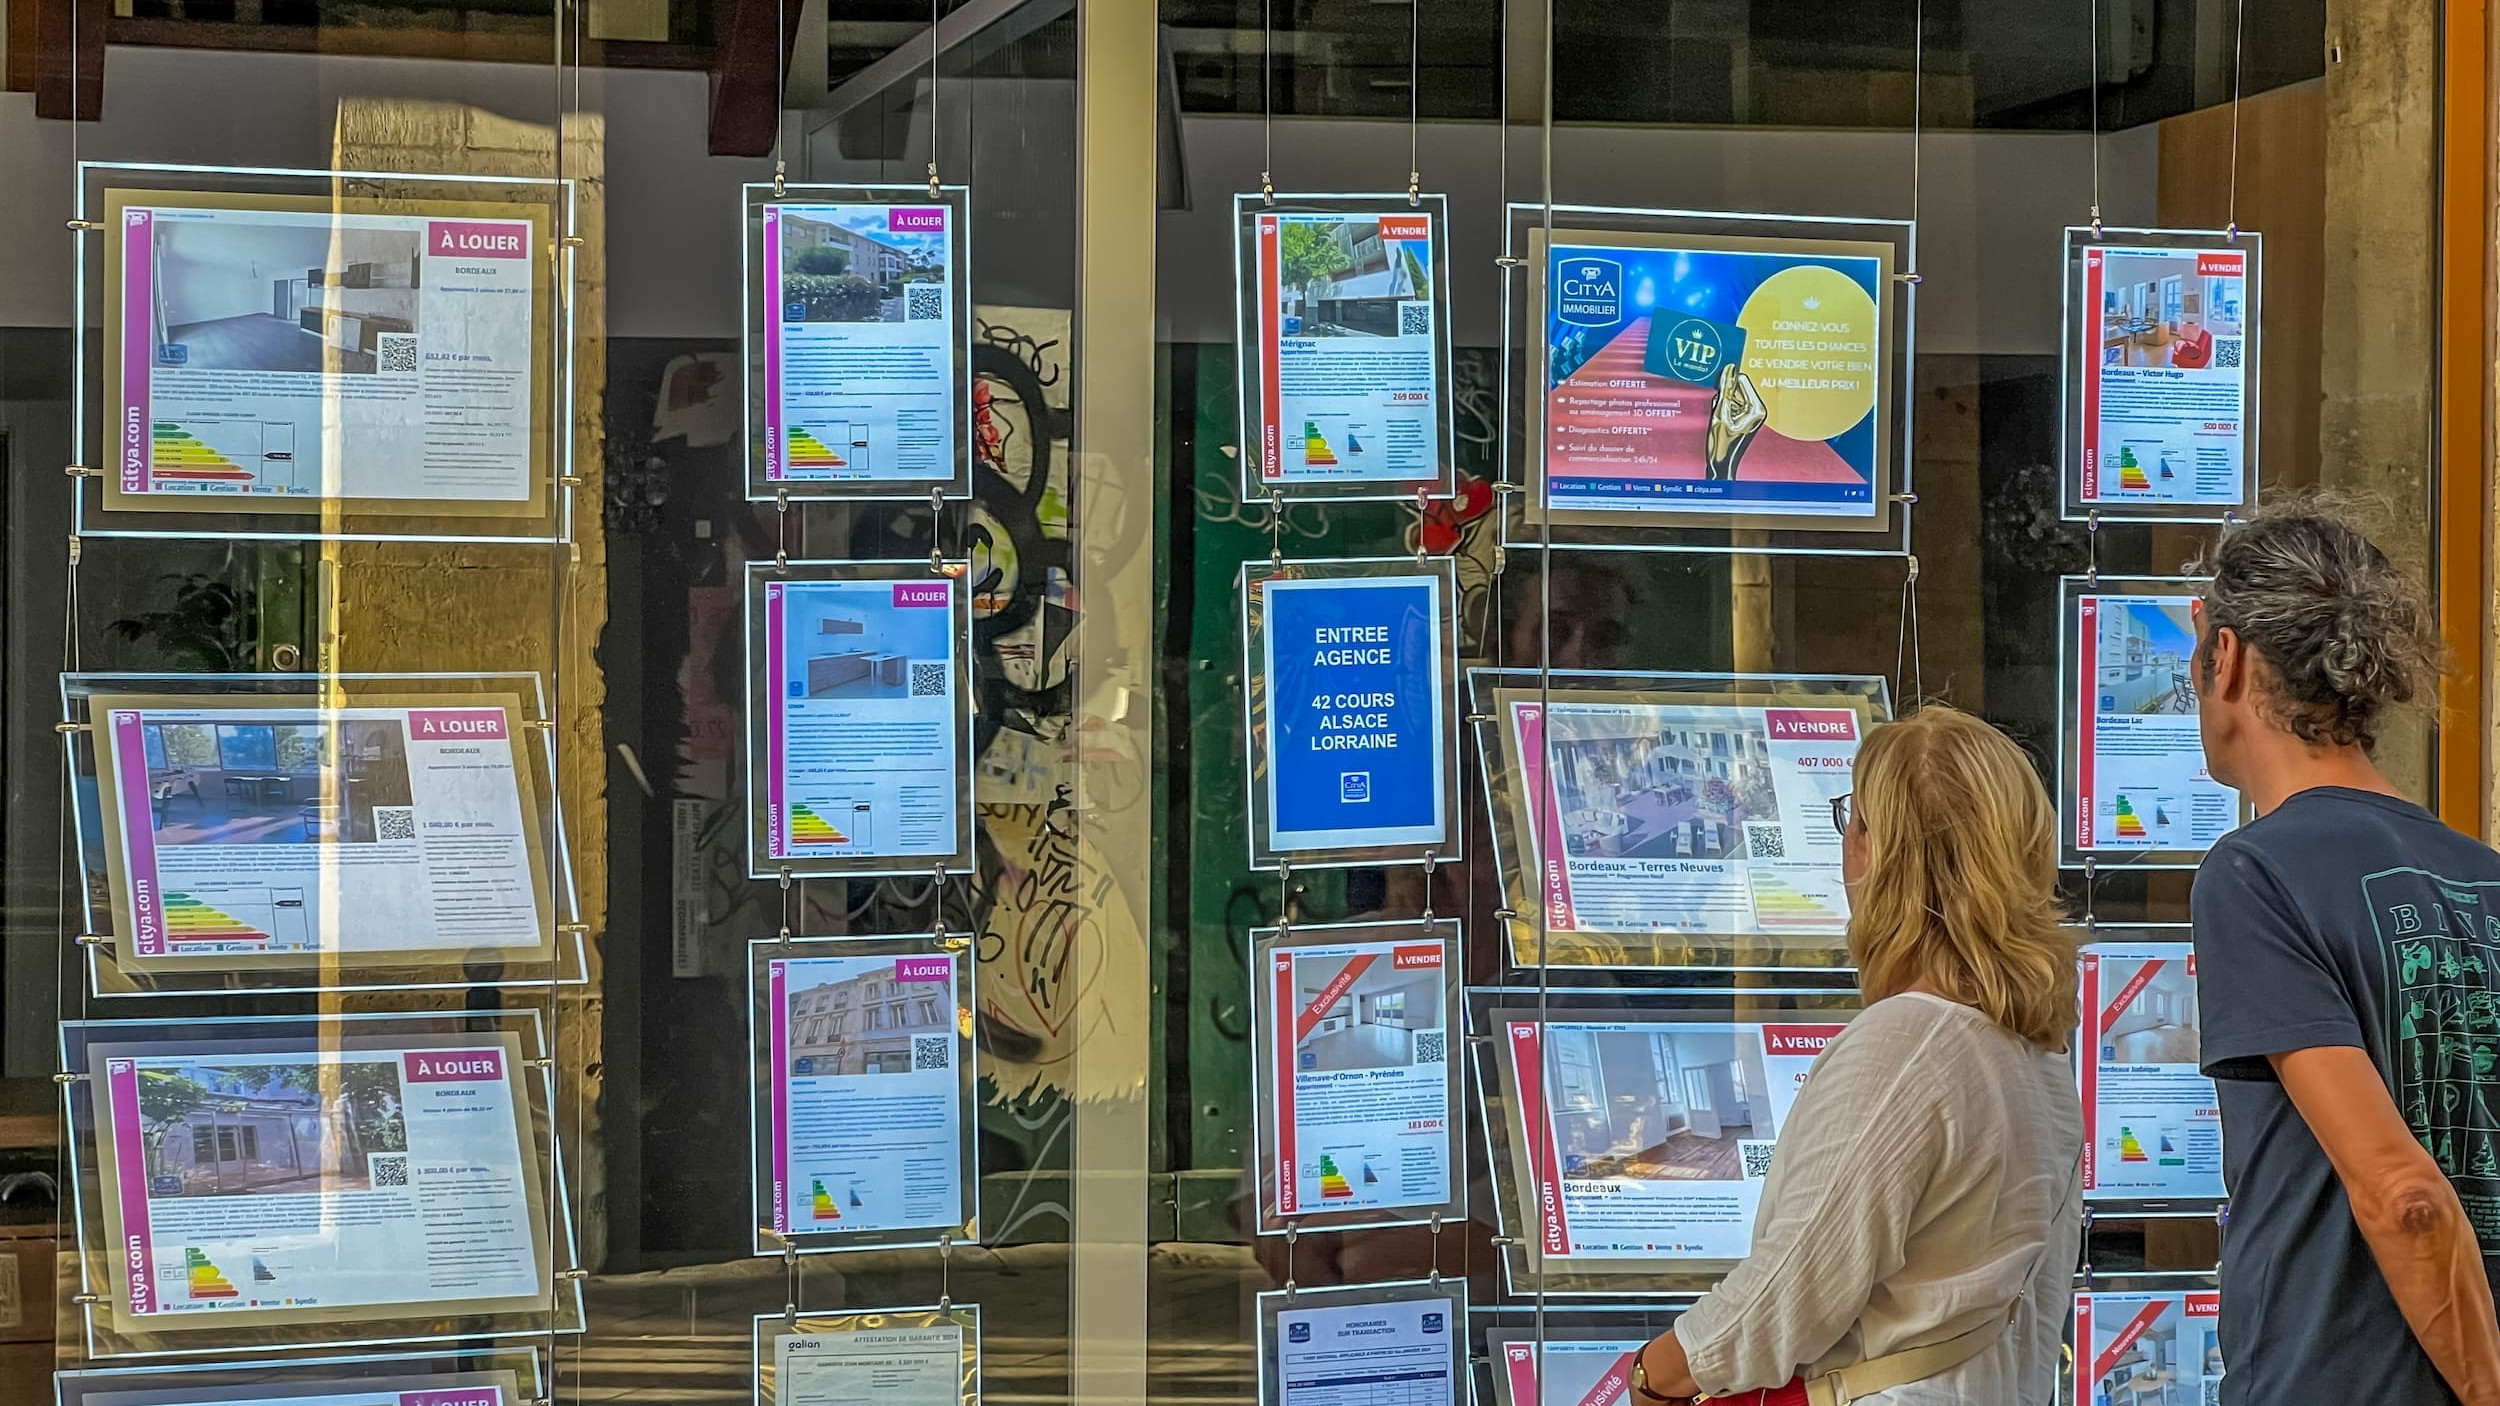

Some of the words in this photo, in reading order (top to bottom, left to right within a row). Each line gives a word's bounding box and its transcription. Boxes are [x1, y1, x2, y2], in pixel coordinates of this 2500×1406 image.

[897, 214, 904, 226] À
[907, 217, 942, 226] LOUER
[1382, 225, 1389, 235] À
[1391, 226, 1426, 235] VENDRE
[441, 230, 454, 248] À
[460, 234, 519, 250] LOUER
[456, 267, 497, 275] BORDEAUX
[2200, 262, 2207, 271] À
[2208, 264, 2242, 272] VENDRE
[1563, 304, 1615, 315] IMMOBILIER
[1773, 321, 1850, 332] DONNEZ-VOUS
[1280, 340, 1316, 348] Mérignac
[1755, 339, 1794, 350] TOUTES
[1797, 341, 1816, 350] LES
[1817, 342, 1866, 352] CHANCES
[1749, 358, 1764, 368] DE
[1765, 359, 1809, 370] VENDRE
[1811, 361, 1845, 370] VOTRE
[1848, 361, 1872, 371] BIEN
[2165, 371, 2184, 379] Hugo
[1570, 379, 1608, 387] Estimation
[1610, 380, 1646, 388] OFFERTE
[1760, 378, 1776, 388] AU
[1778, 378, 1828, 389] MEILLEUR
[1832, 380, 1855, 390] PRIX
[1569, 396, 1607, 406] Reportage
[1609, 398, 1632, 407] photos
[1634, 399, 1681, 408] professionnel
[1569, 426, 1609, 435] Diagnostics
[123, 406, 143, 491] citya.com
[768, 426, 777, 479] citya.com
[1266, 425, 1276, 474] citya.com
[1569, 443, 1586, 451] Suivi
[1626, 445, 1635, 453] de
[2085, 448, 2094, 495] citya.com
[210, 484, 237, 492] Gestion
[1633, 484, 1650, 492] Vente
[1662, 485, 1682, 493] Syndic
[1694, 485, 1723, 494] citya.com
[901, 589, 909, 601] À
[912, 592, 946, 602] LOUER
[1316, 626, 1389, 644] ENTREE
[1314, 648, 1391, 666] AGENCE
[1312, 695, 1331, 710] 42
[1335, 693, 1394, 709] COURS
[423, 718, 435, 733] À
[440, 720, 498, 733] LOUER
[1320, 713, 1388, 730] ALSACE
[1776, 719, 1786, 733] À
[1788, 722, 1848, 733] VENDRE
[2096, 716, 2129, 724] Bordeaux
[1311, 733, 1397, 750] LORRAINE
[1798, 757, 1818, 767] 407
[1822, 757, 1843, 767] 000
[1846, 758, 1853, 766] €
[2081, 797, 2089, 844] citya.com
[770, 804, 780, 856] citya.com
[1569, 861, 1627, 871] Bordeaux
[1639, 862, 1677, 872] Terres
[1681, 863, 1724, 873] Neuves
[1548, 860, 1567, 927] citya.com
[137, 879, 157, 954] citya.com
[1397, 955, 1404, 965] À
[1405, 954, 1441, 965] VENDRE
[903, 964, 911, 976] À
[913, 965, 949, 976] LOUER
[1312, 973, 1352, 1015] Exclusivité
[1772, 1034, 1783, 1048] À
[1785, 1037, 1833, 1048] VEND
[418, 1059, 431, 1076] À
[435, 1061, 494, 1074] LOUER
[1296, 1071, 1364, 1083] Villenave-d'Ornon
[1423, 1120, 1437, 1128] 000
[2084, 1142, 2092, 1187] citya.com
[1282, 1160, 1293, 1210] citya.com
[1564, 1183, 1621, 1193] Bordeaux
[775, 1181, 784, 1233] citya.com
[1543, 1181, 1562, 1252] citya.com
[130, 1235, 149, 1313] citya.com
[173, 1302, 204, 1310] Location
[218, 1301, 246, 1309] Gestion
[2188, 1302, 2195, 1312] À
[2195, 1304, 2219, 1312] VEND
[1346, 1320, 1387, 1328] HONORAIRES
[1352, 1328, 1396, 1336] TRANSACTION
[788, 1340, 820, 1352] galian
